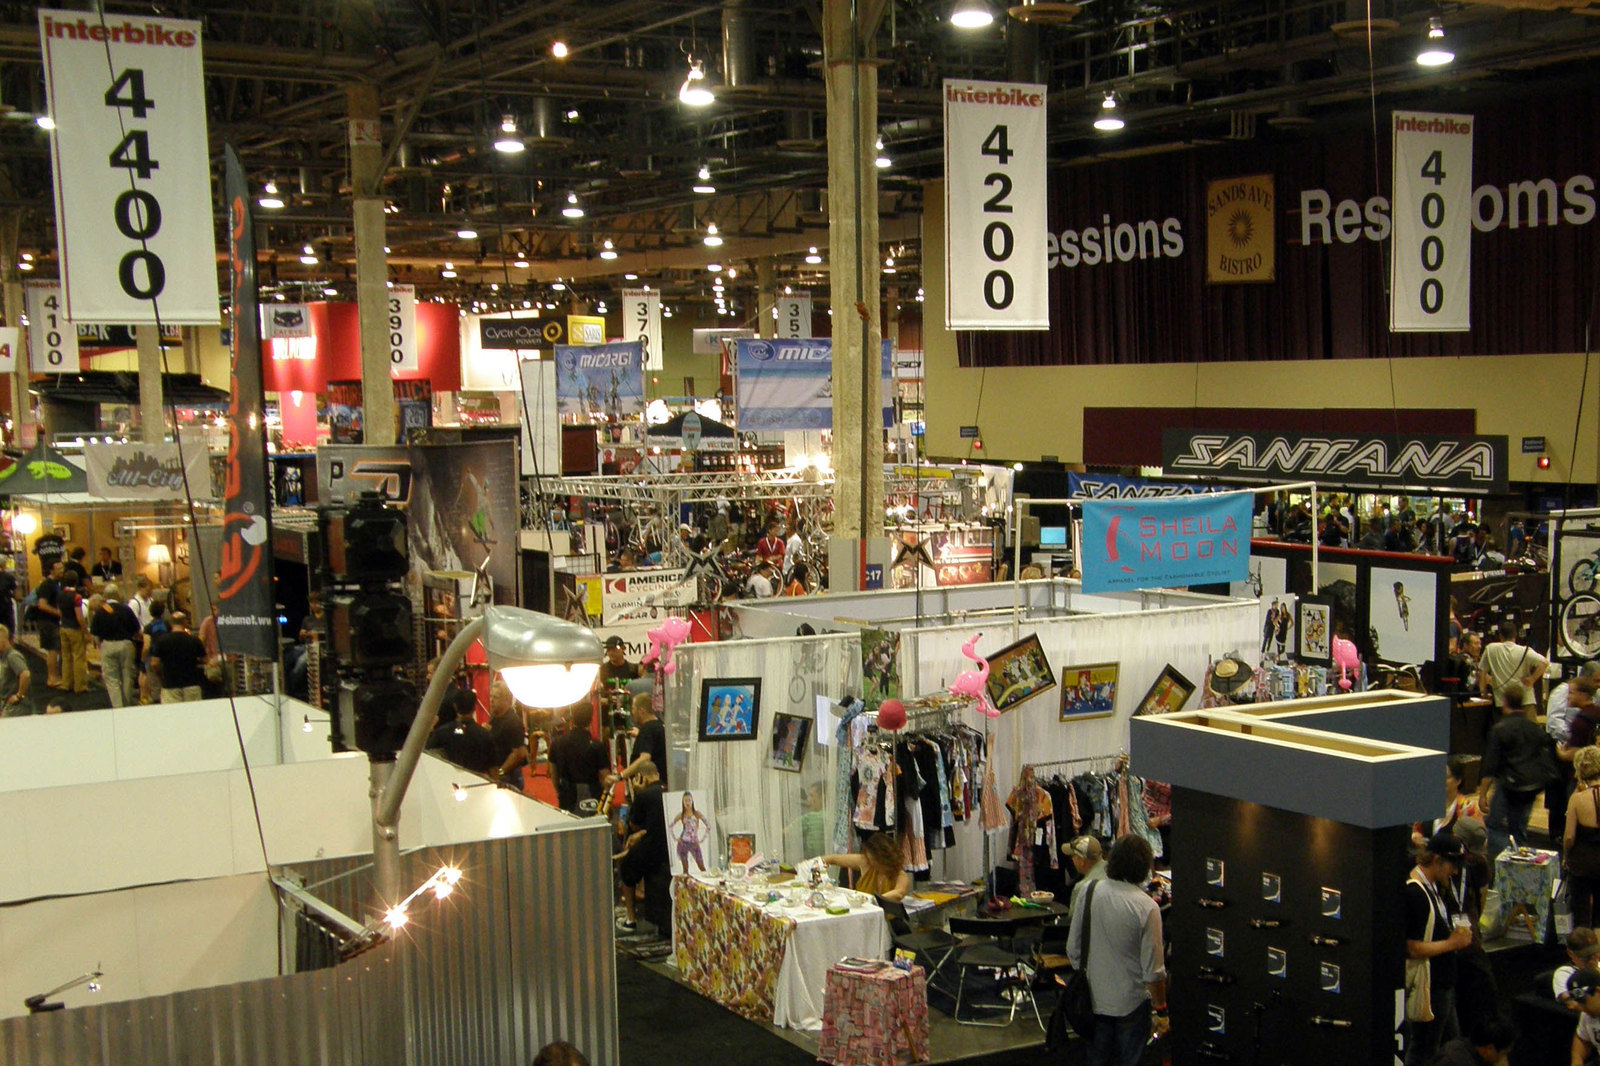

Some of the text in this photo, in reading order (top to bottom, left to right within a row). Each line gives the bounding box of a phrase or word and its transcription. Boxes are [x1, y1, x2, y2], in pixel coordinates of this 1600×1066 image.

[43, 16, 198, 49] interbike
[945, 84, 1039, 108] interbike
[1395, 115, 1471, 136] interbike
[104, 67, 167, 301] 4400
[1207, 183, 1273, 218] SANDS AVE
[980, 124, 1014, 311] 4200
[1419, 150, 1446, 315] 4000
[1218, 252, 1263, 276] BISTRO
[44, 295, 63, 366] 4100
[389, 298, 404, 363] 3900
[579, 351, 633, 369] MICARGI
[1172, 434, 1496, 482] SANTANA
[1138, 515, 1238, 539] SHEILA
[1141, 538, 1238, 563] MOON
[1151, 574, 1163, 582] THE
[610, 601, 643, 610] GARMIN
[617, 612, 648, 621] POLAR
